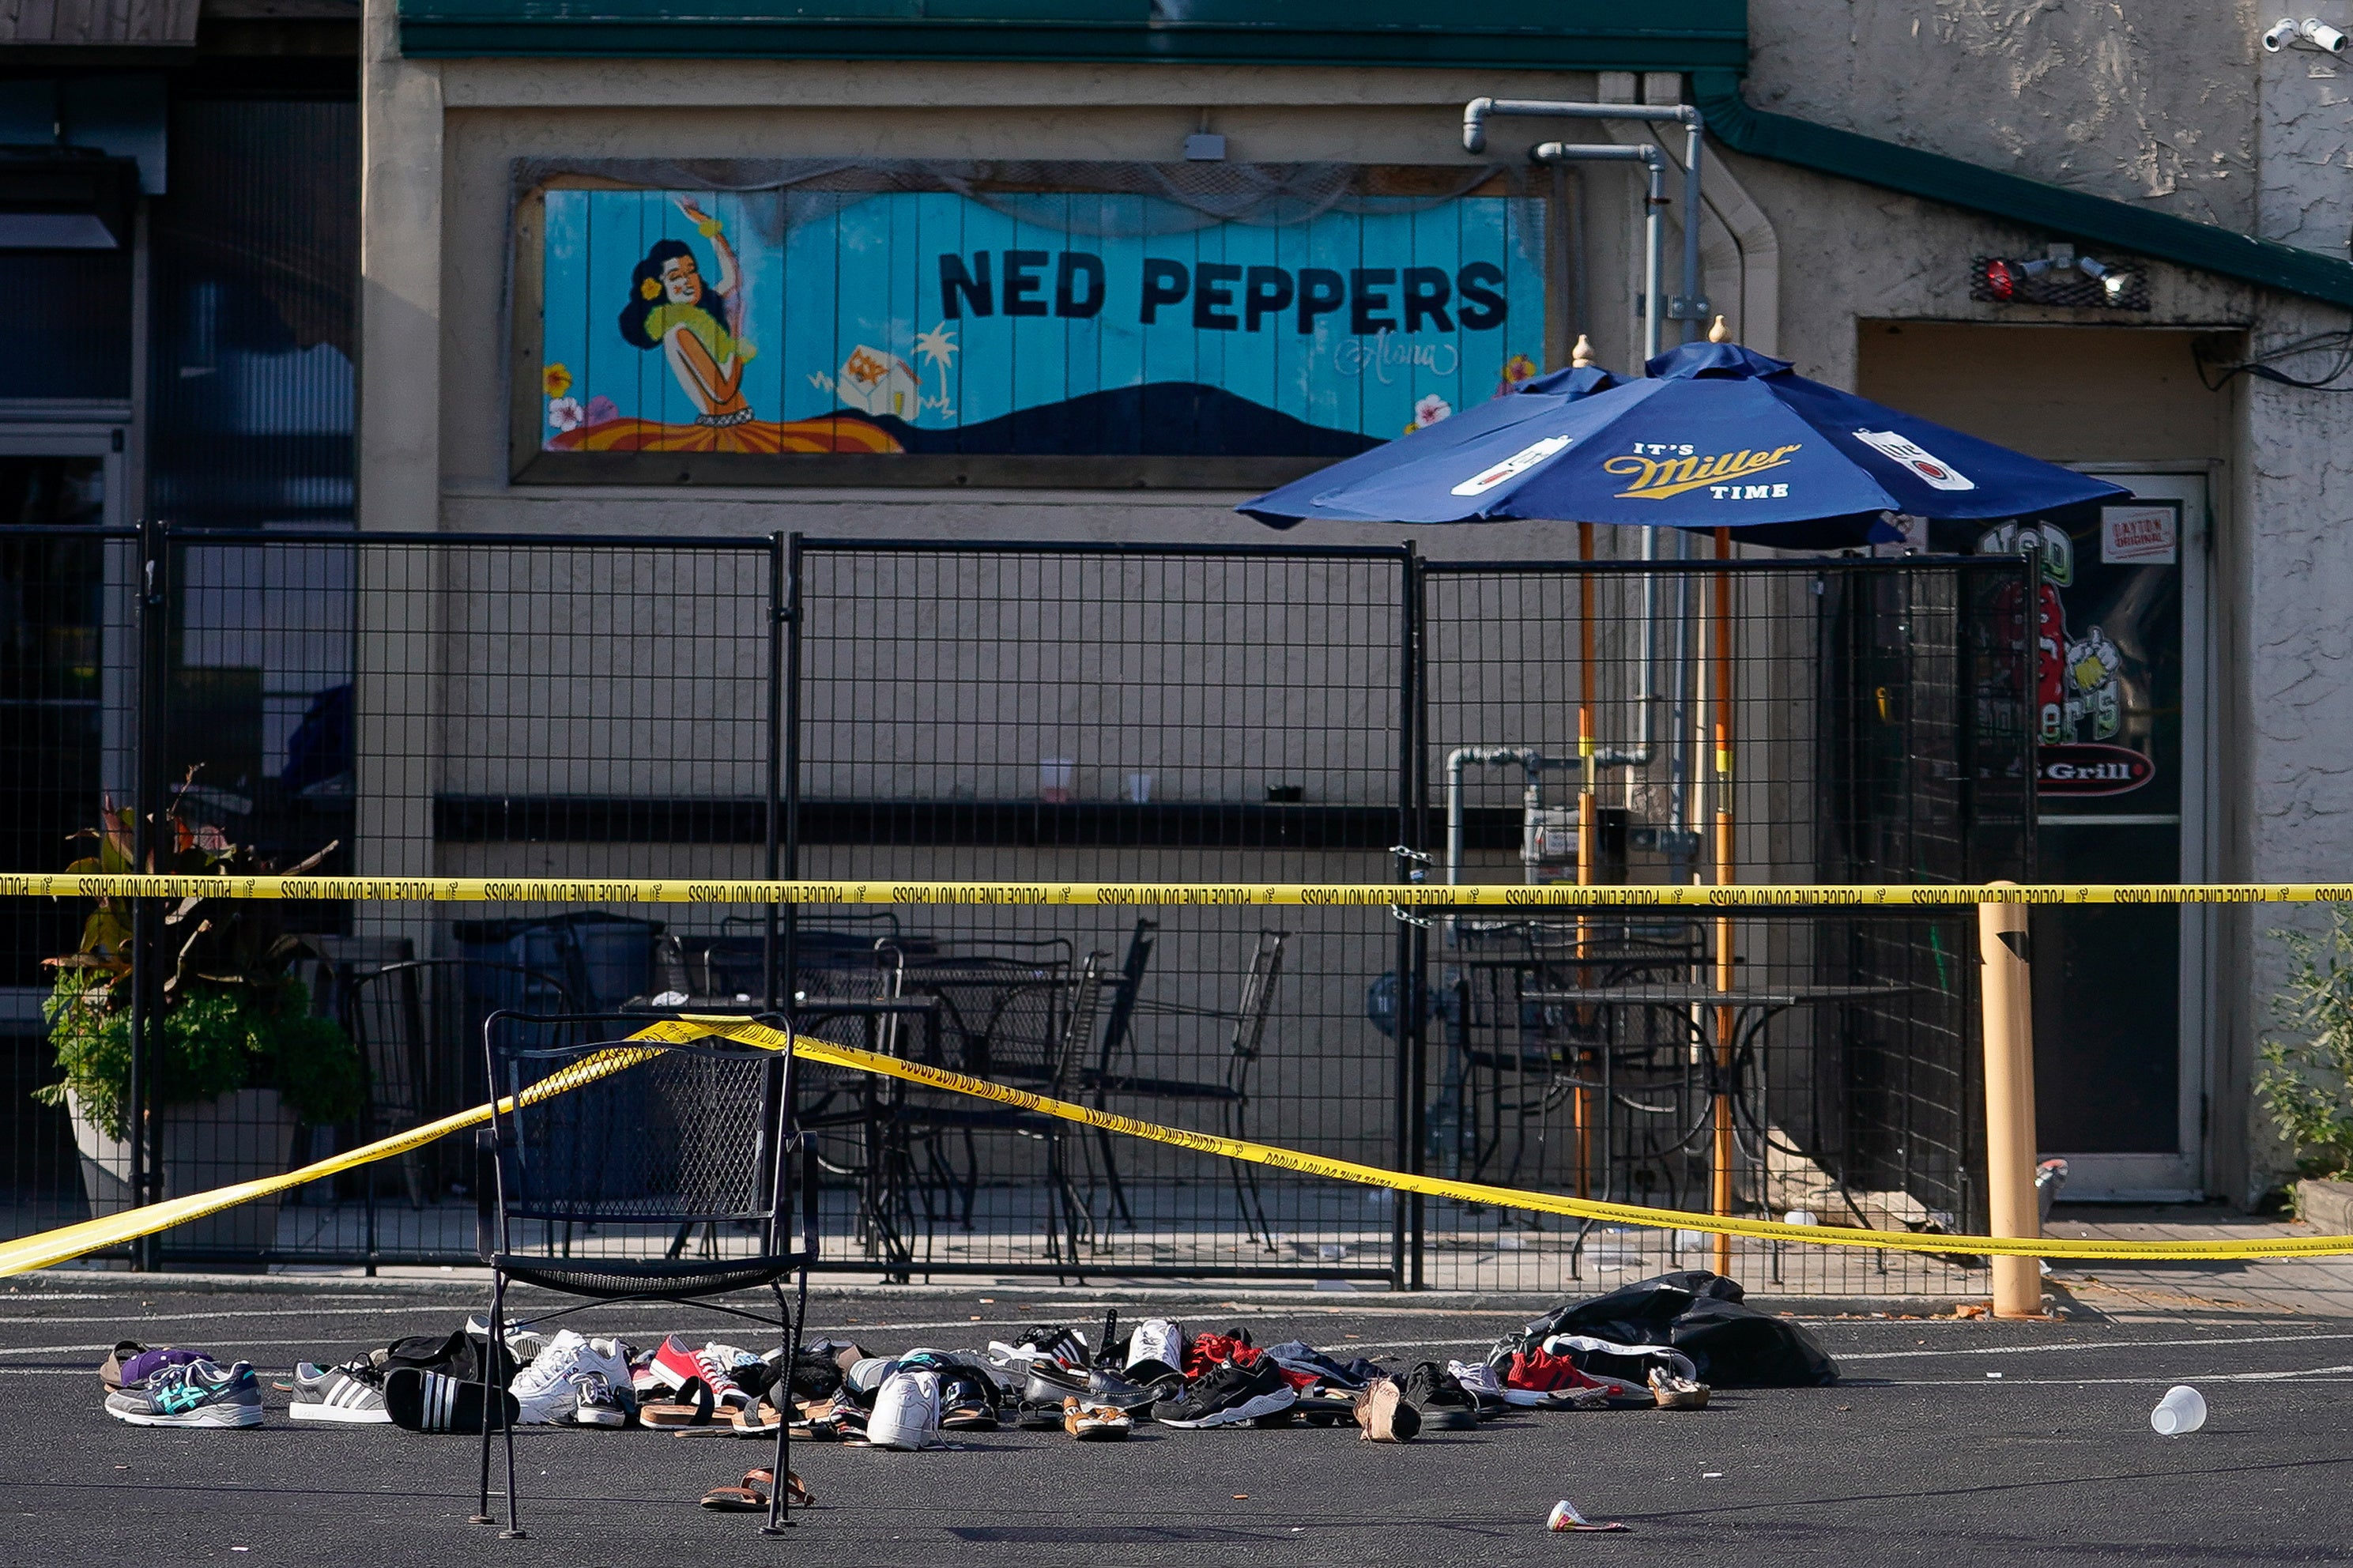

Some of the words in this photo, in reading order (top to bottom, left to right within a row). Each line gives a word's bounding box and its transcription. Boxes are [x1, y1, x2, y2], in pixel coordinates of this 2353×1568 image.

[939, 250, 1105, 320] NED
[1140, 258, 1509, 336] PEPPERS
[1633, 443, 1694, 456] IT'S
[1604, 443, 1802, 492] Miller
[1710, 484, 1789, 499] TIME
[2047, 764, 2131, 780] Grill
[78, 877, 116, 896] CROSS
[145, 878, 160, 897] DO
[164, 878, 188, 898] LINE
[191, 879, 231, 898] POLICE
[281, 880, 319, 899] CROSS
[347, 880, 363, 899] DO
[366, 880, 391, 899] LINE
[394, 881, 434, 899] POLICE
[484, 882, 522, 900] CROSS
[551, 883, 567, 901] DO
[570, 883, 595, 901] LINE
[598, 883, 638, 901] POLICE
[688, 884, 726, 902] CROSS
[755, 884, 771, 903] DO
[774, 884, 800, 903] LINE
[803, 884, 843, 903] POLICE
[892, 886, 930, 903] CROSS
[960, 886, 975, 904] DO
[979, 887, 1004, 904] LINE
[1007, 887, 1046, 904] POLICE
[1097, 887, 1135, 904] CROSS
[1163, 887, 1179, 904] DO
[1794, 888, 1819, 903] LINE
[1997, 888, 2021, 903] LINE
[2198, 888, 2223, 902] LINE
[1182, 888, 1209, 904] LINE
[1212, 888, 1251, 904] POLICE
[1301, 888, 1339, 904] CROSS
[1367, 888, 1383, 904] DO
[1386, 888, 1412, 904] LINE
[1416, 888, 1455, 904] POLICE
[1590, 888, 1616, 904] LINE
